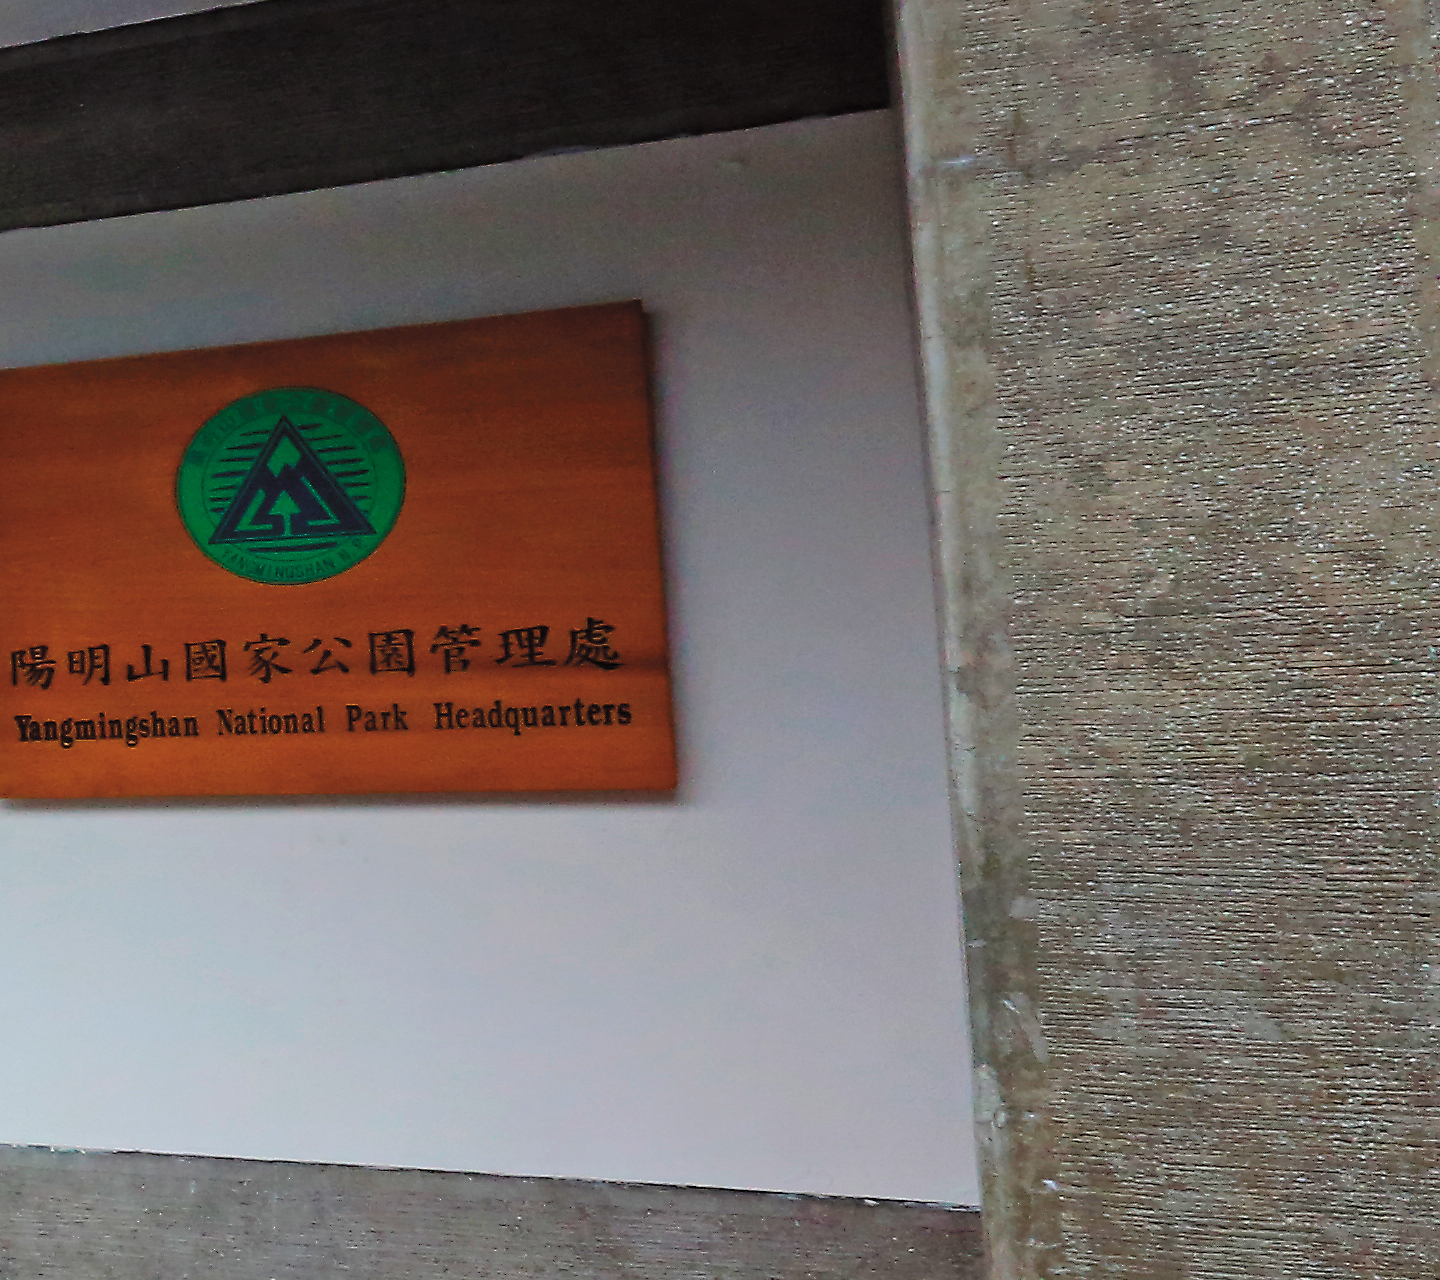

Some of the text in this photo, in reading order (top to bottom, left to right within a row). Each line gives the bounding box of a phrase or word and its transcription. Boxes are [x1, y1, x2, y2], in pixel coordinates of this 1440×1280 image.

[11, 617, 626, 690] 陽明山國家公園管理處
[13, 697, 633, 749] Yangmingshan National Park Headquarters
